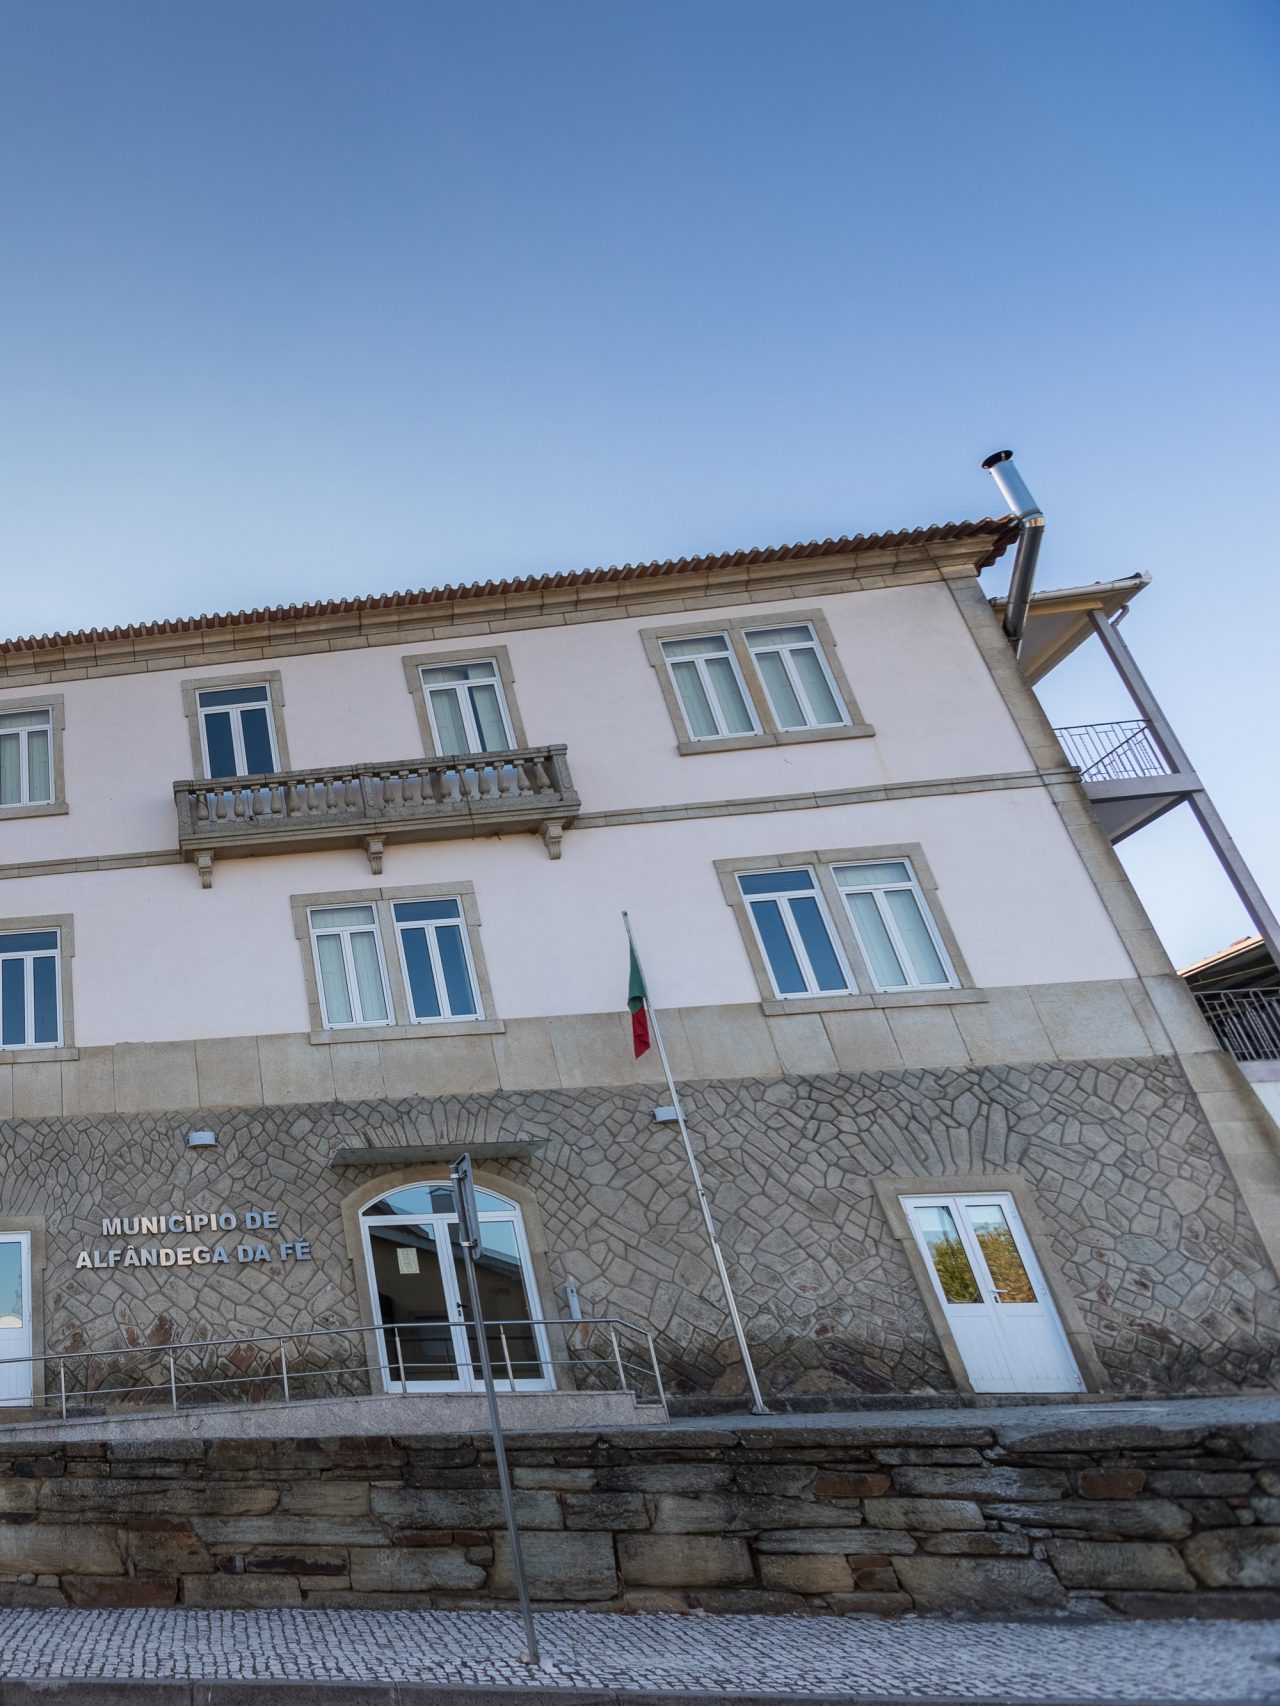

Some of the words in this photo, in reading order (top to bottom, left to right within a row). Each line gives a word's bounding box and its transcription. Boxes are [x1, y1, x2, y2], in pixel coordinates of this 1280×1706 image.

[102, 1210, 237, 1236] MUNICÍPIO
[245, 1210, 279, 1230] DE
[76, 1244, 229, 1268] ALFÂNDEGA
[237, 1244, 271, 1263] DA
[279, 1236, 312, 1261] FÉ
